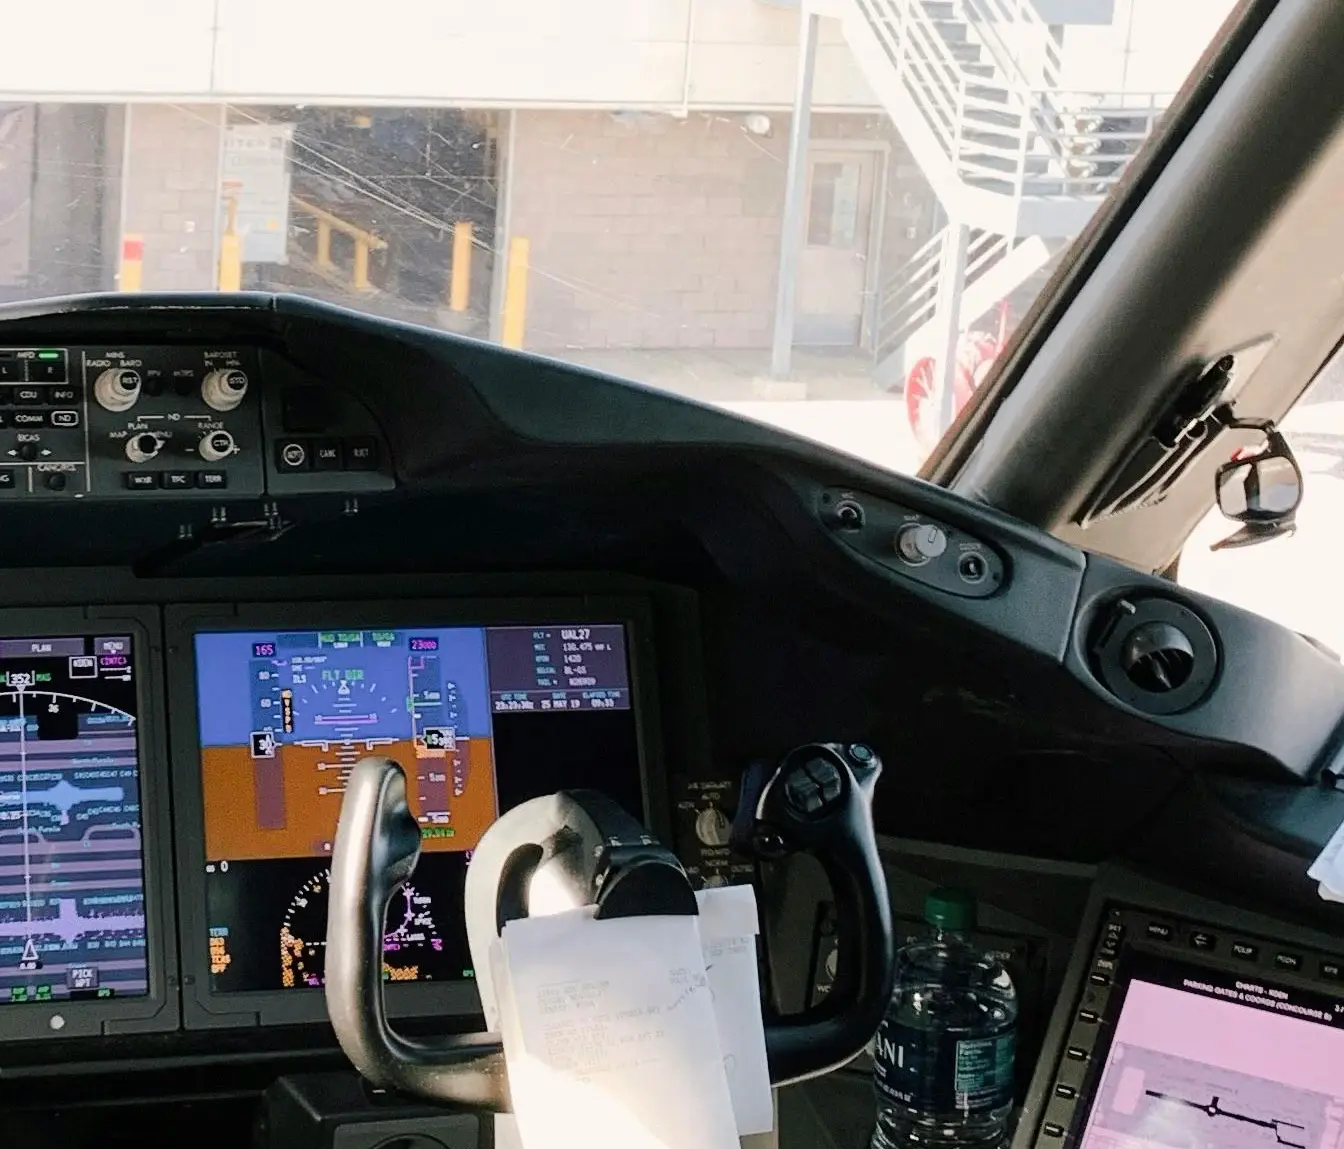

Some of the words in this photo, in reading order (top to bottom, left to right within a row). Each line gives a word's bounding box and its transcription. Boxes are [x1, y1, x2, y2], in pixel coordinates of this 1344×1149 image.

[122, 376, 139, 385] RST
[411, 639, 437, 650] 23000
[255, 645, 273, 656] 165
[11, 673, 30, 684] 352
[322, 670, 342, 681] FLT
